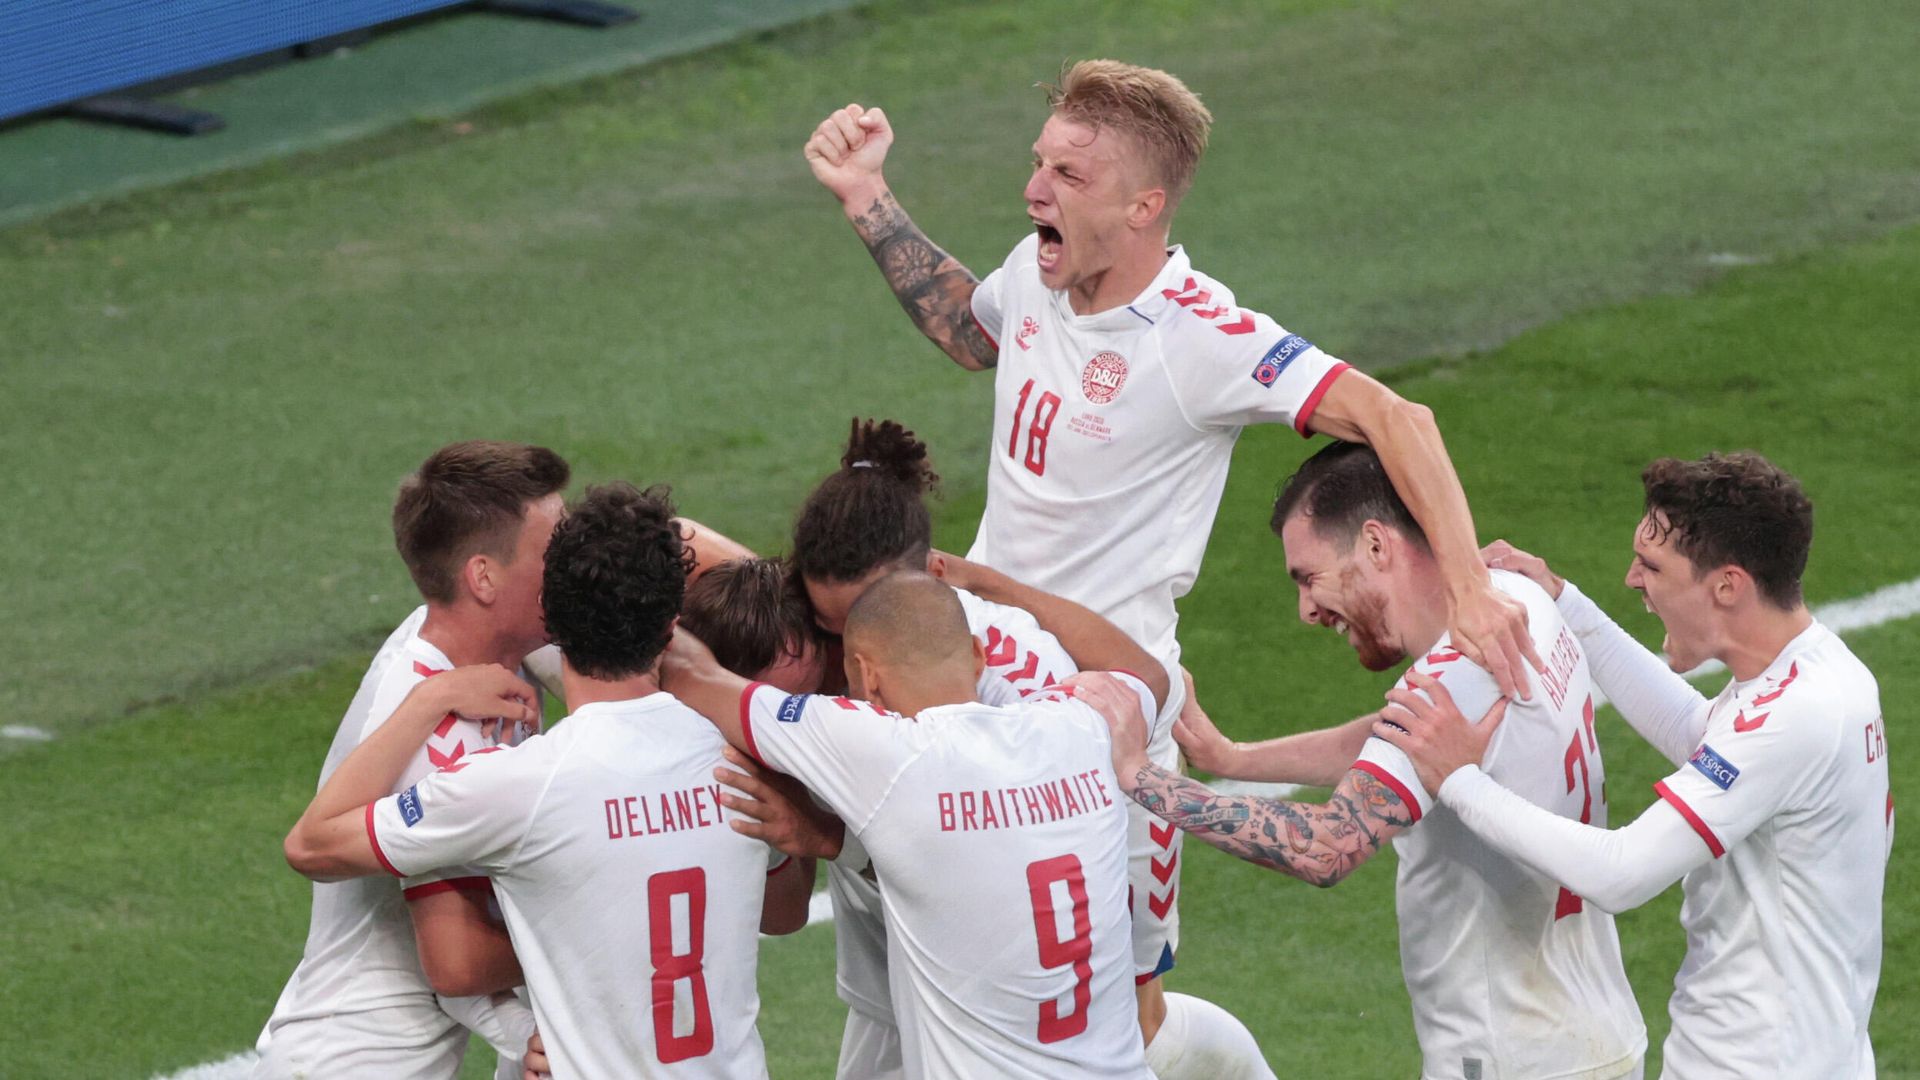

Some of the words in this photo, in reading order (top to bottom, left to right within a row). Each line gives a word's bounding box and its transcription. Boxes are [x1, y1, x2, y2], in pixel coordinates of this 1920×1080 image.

[1091, 367, 1121, 388] DBU
[1270, 336, 1307, 367] RESPECT
[1009, 378, 1062, 477] 18
[1696, 752, 1736, 784] RESPECT
[605, 784, 723, 840] DELANEY
[938, 769, 1112, 832] BRAITHWAITE
[647, 866, 714, 1064] 8
[1026, 853, 1093, 1044] 9
